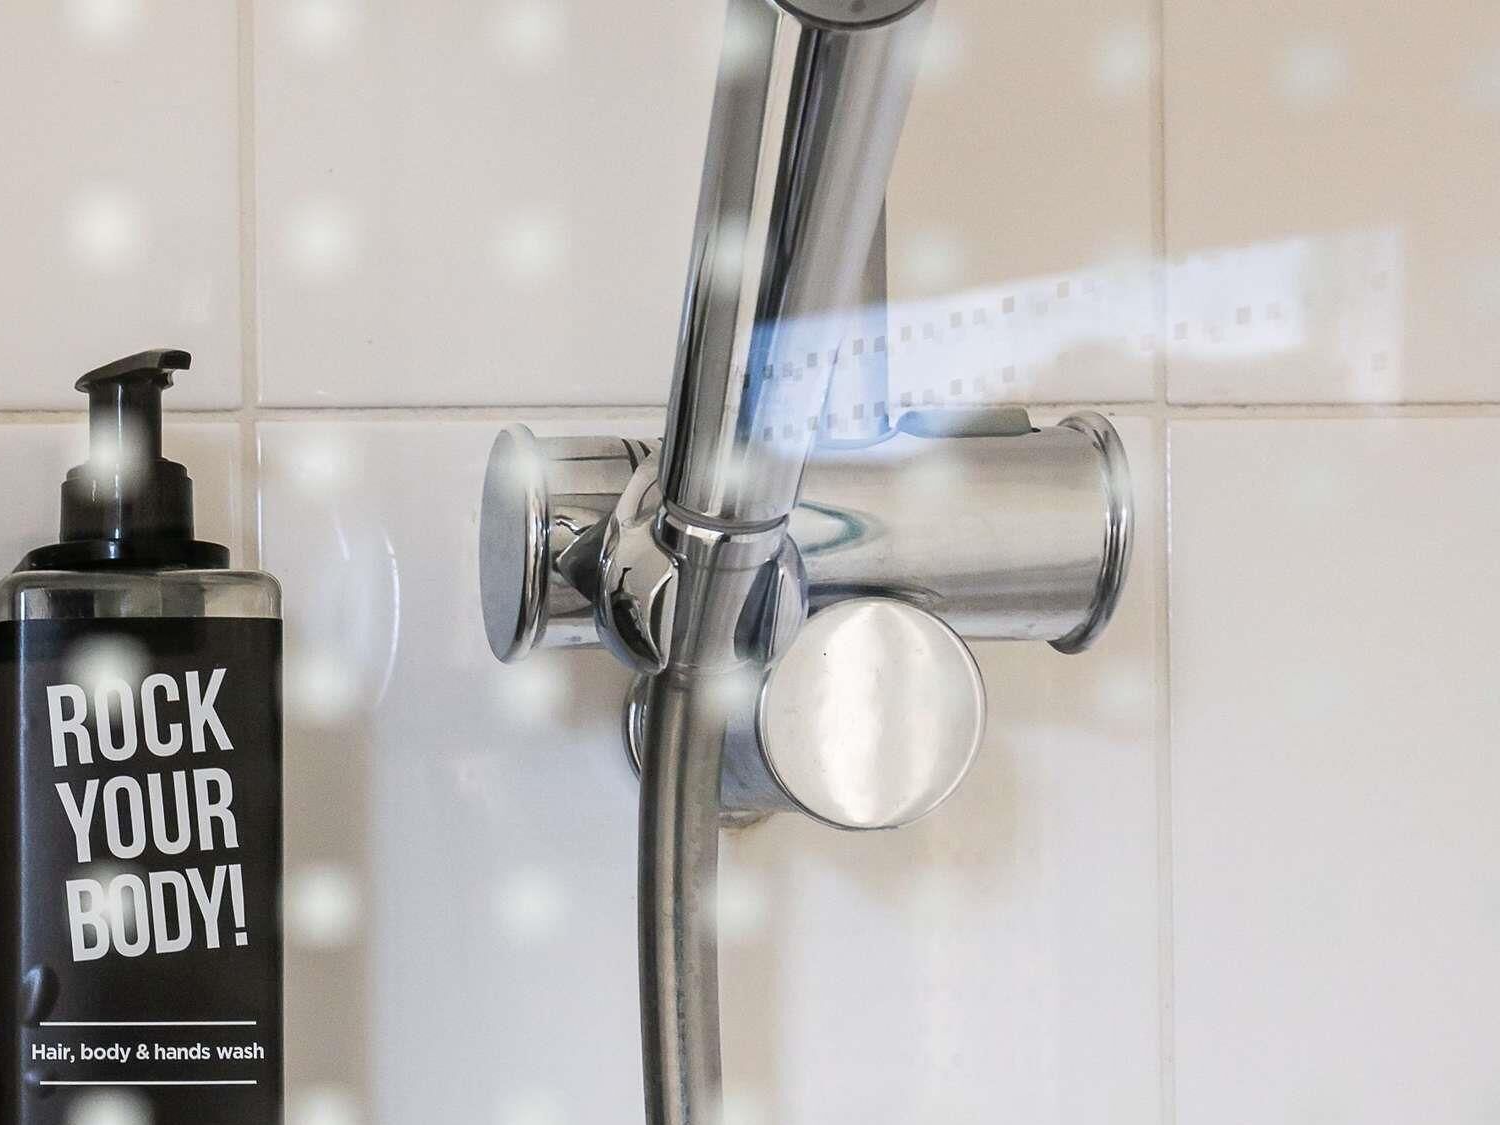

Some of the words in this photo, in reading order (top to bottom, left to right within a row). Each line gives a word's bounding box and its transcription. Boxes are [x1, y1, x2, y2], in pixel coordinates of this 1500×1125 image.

[46, 668, 234, 767] ROCK
[54, 767, 240, 863] YOUR
[65, 864, 249, 962] BODY!
[31, 1043, 75, 1063] Hair,
[80, 1043, 131, 1063] body
[136, 1044, 150, 1060] &
[154, 1043, 211, 1061] hands
[216, 1042, 265, 1060] wash
